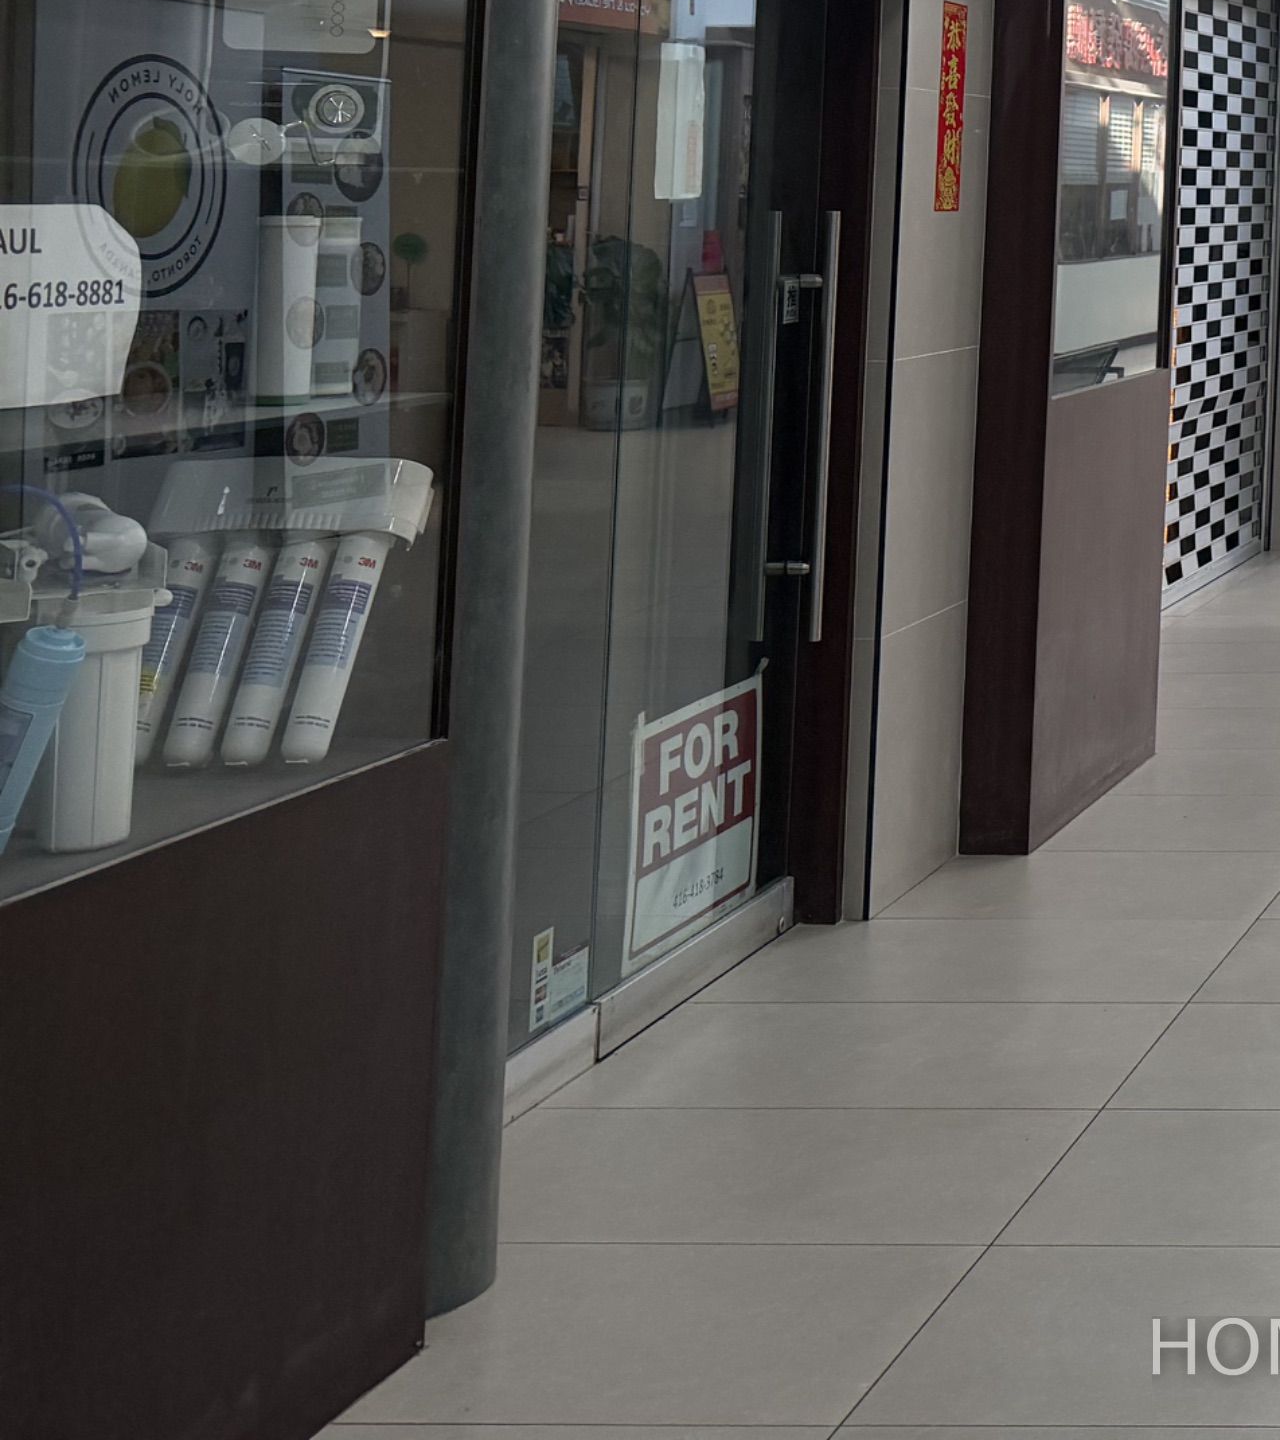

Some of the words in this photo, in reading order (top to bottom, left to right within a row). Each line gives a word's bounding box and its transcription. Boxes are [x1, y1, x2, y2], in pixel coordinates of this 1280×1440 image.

[0, 279, 125, 310] 6-618-8881
[185, 560, 203, 574] 3M
[243, 558, 262, 572] 3M
[299, 556, 318, 570] 3M
[358, 556, 377, 570] 3M
[659, 708, 739, 795] FOR
[642, 759, 751, 868] RENT
